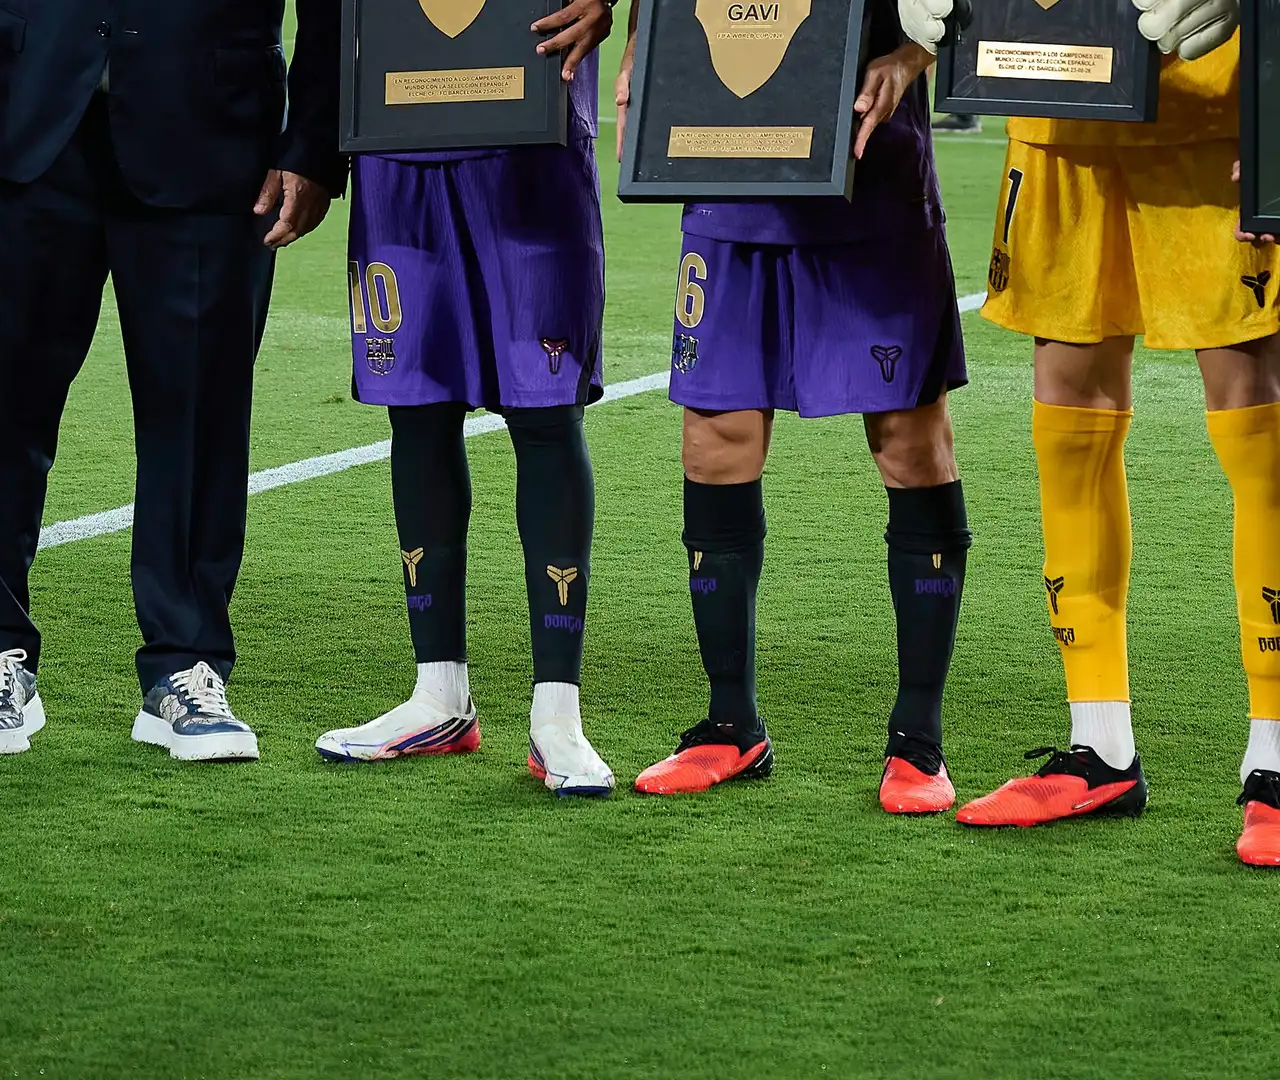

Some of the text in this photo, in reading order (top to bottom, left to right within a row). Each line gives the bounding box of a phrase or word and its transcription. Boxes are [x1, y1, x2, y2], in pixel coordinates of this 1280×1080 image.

[728, 4, 779, 21] GAVI
[348, 260, 402, 334] 10
[675, 252, 707, 328] 6
